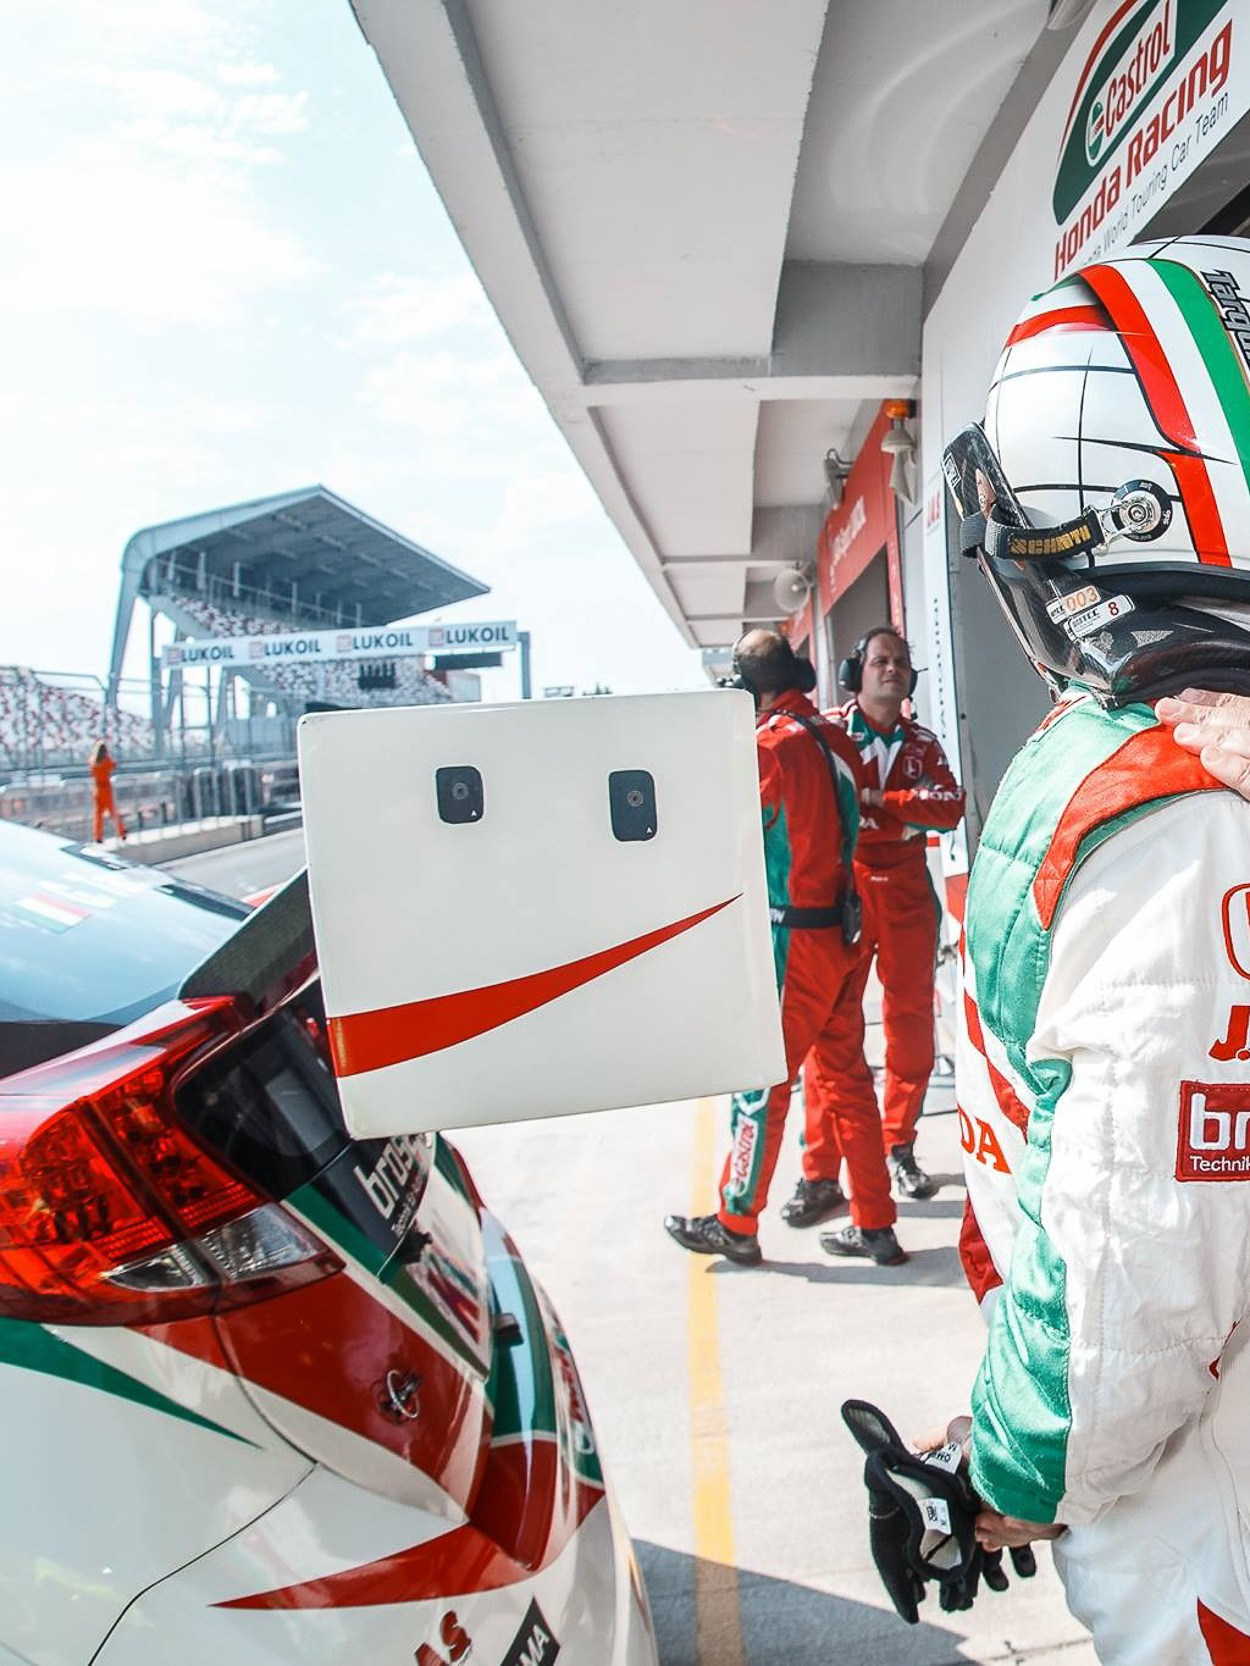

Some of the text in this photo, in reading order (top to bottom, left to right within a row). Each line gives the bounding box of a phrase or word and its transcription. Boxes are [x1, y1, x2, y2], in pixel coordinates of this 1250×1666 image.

[1105, 0, 1170, 137] Castrol
[1054, 19, 1233, 281] Honda Racing
[1131, 160, 1168, 220] Touring
[1171, 134, 1193, 172] Car
[1195, 92, 1229, 144] Team
[1066, 586, 1098, 612] 003
[1108, 601, 1119, 616] 8
[181, 627, 509, 662] LUKOIL LUKOIL LUKOIL LUKOIL
